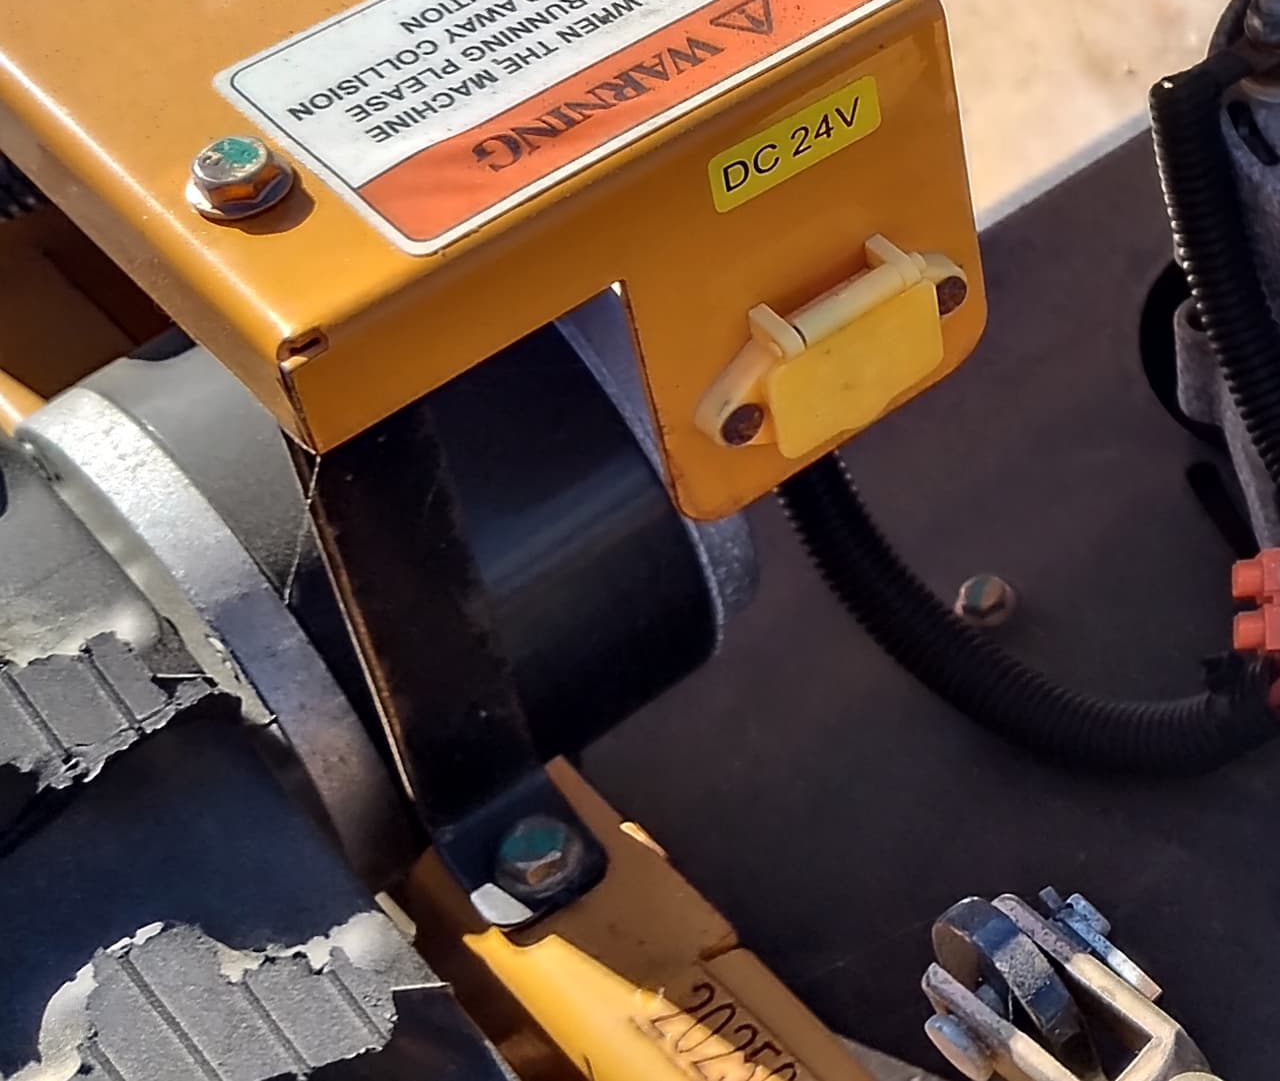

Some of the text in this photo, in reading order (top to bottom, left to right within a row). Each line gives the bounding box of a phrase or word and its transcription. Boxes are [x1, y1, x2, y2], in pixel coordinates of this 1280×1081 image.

[286, 40, 438, 122] COLLISION
[345, 58, 461, 123] PLEASE
[365, 70, 499, 143] MACHINE
[471, 36, 726, 172] WARNING
[722, 96, 860, 193] DC 24V
